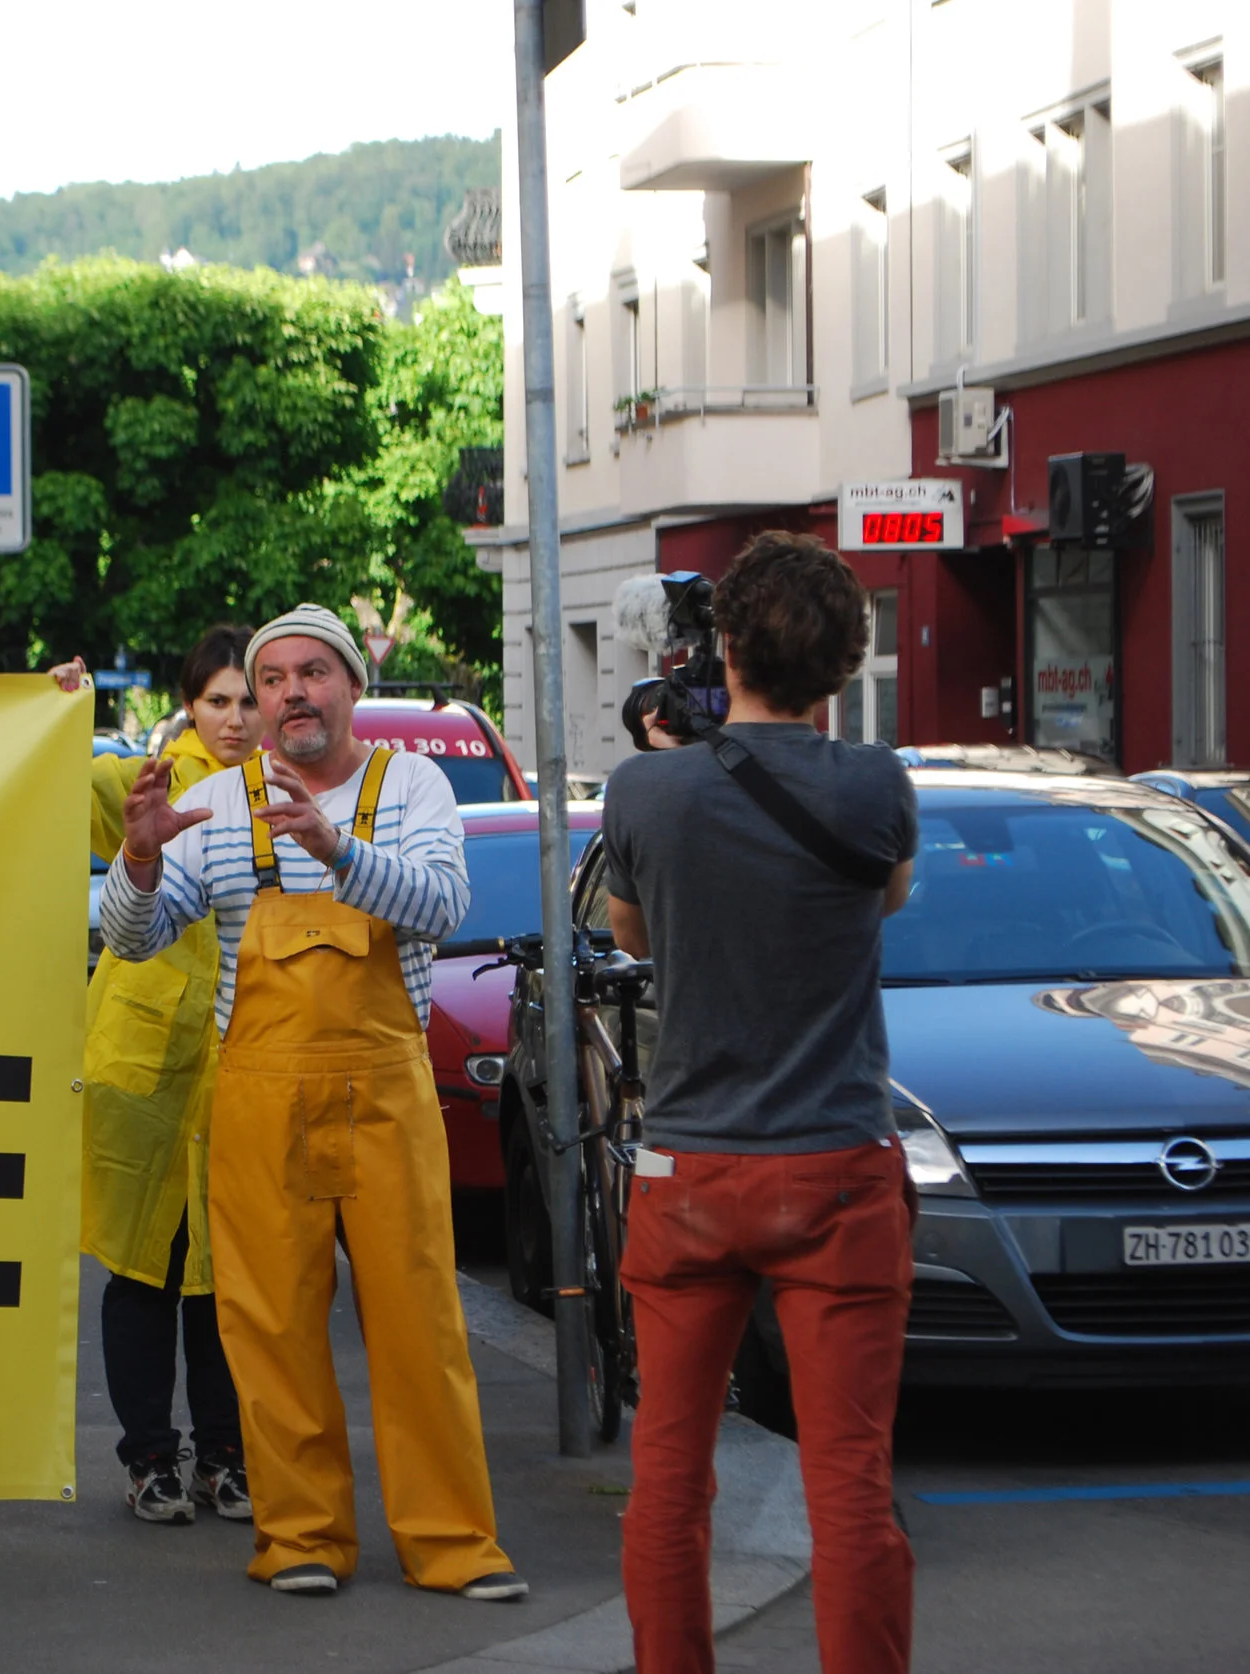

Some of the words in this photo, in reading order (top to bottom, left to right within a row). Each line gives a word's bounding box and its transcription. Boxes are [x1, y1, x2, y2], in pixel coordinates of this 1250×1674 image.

[850, 483, 927, 502] mbt-ag.ch
[414, 738, 447, 755] 30
[455, 739, 487, 757] 10
